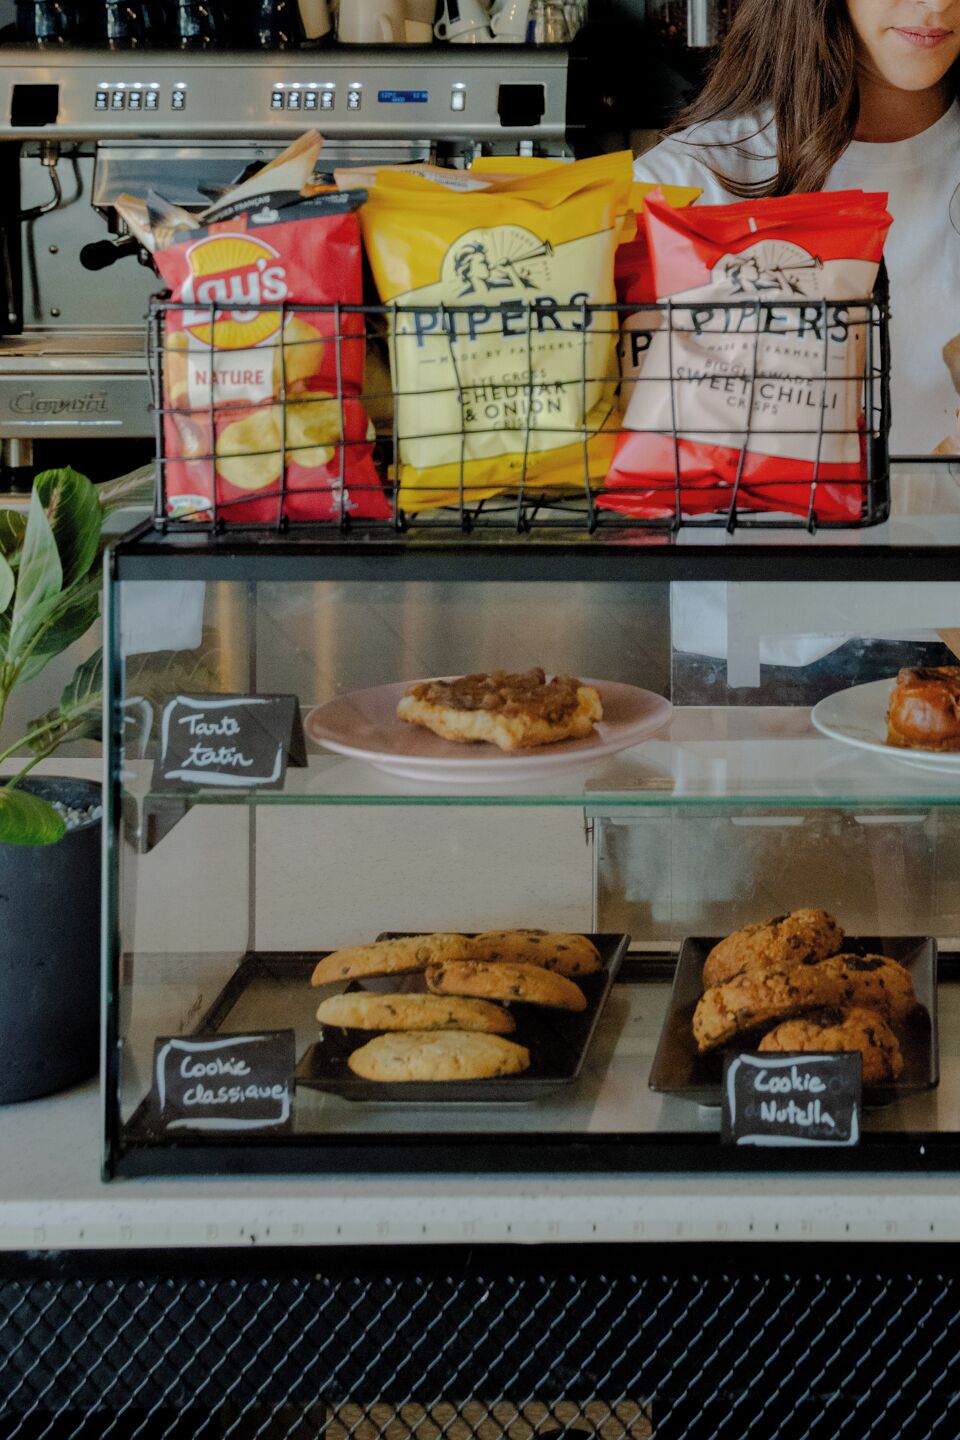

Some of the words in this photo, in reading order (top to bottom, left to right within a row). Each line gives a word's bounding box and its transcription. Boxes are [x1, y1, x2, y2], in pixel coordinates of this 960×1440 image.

[182, 258, 288, 327] Lay's
[413, 292, 593, 348] PIPERS
[689, 303, 849, 343] PIPERS
[440, 352, 476, 363] MDE
[510, 341, 572, 355] FAMERS
[765, 346, 826, 360] FARMER
[195, 370, 265, 385] NATURE
[676, 366, 752, 395] SWEET
[759, 383, 838, 410] CHILLI
[484, 398, 562, 419] ONION
[726, 395, 779, 414] CRSPS
[178, 713, 241, 736] Tarte
[181, 742, 255, 768] tatin
[180, 1055, 251, 1079] Cookie
[753, 1064, 828, 1093] Cookie
[760, 1099, 836, 1128] Nutella
